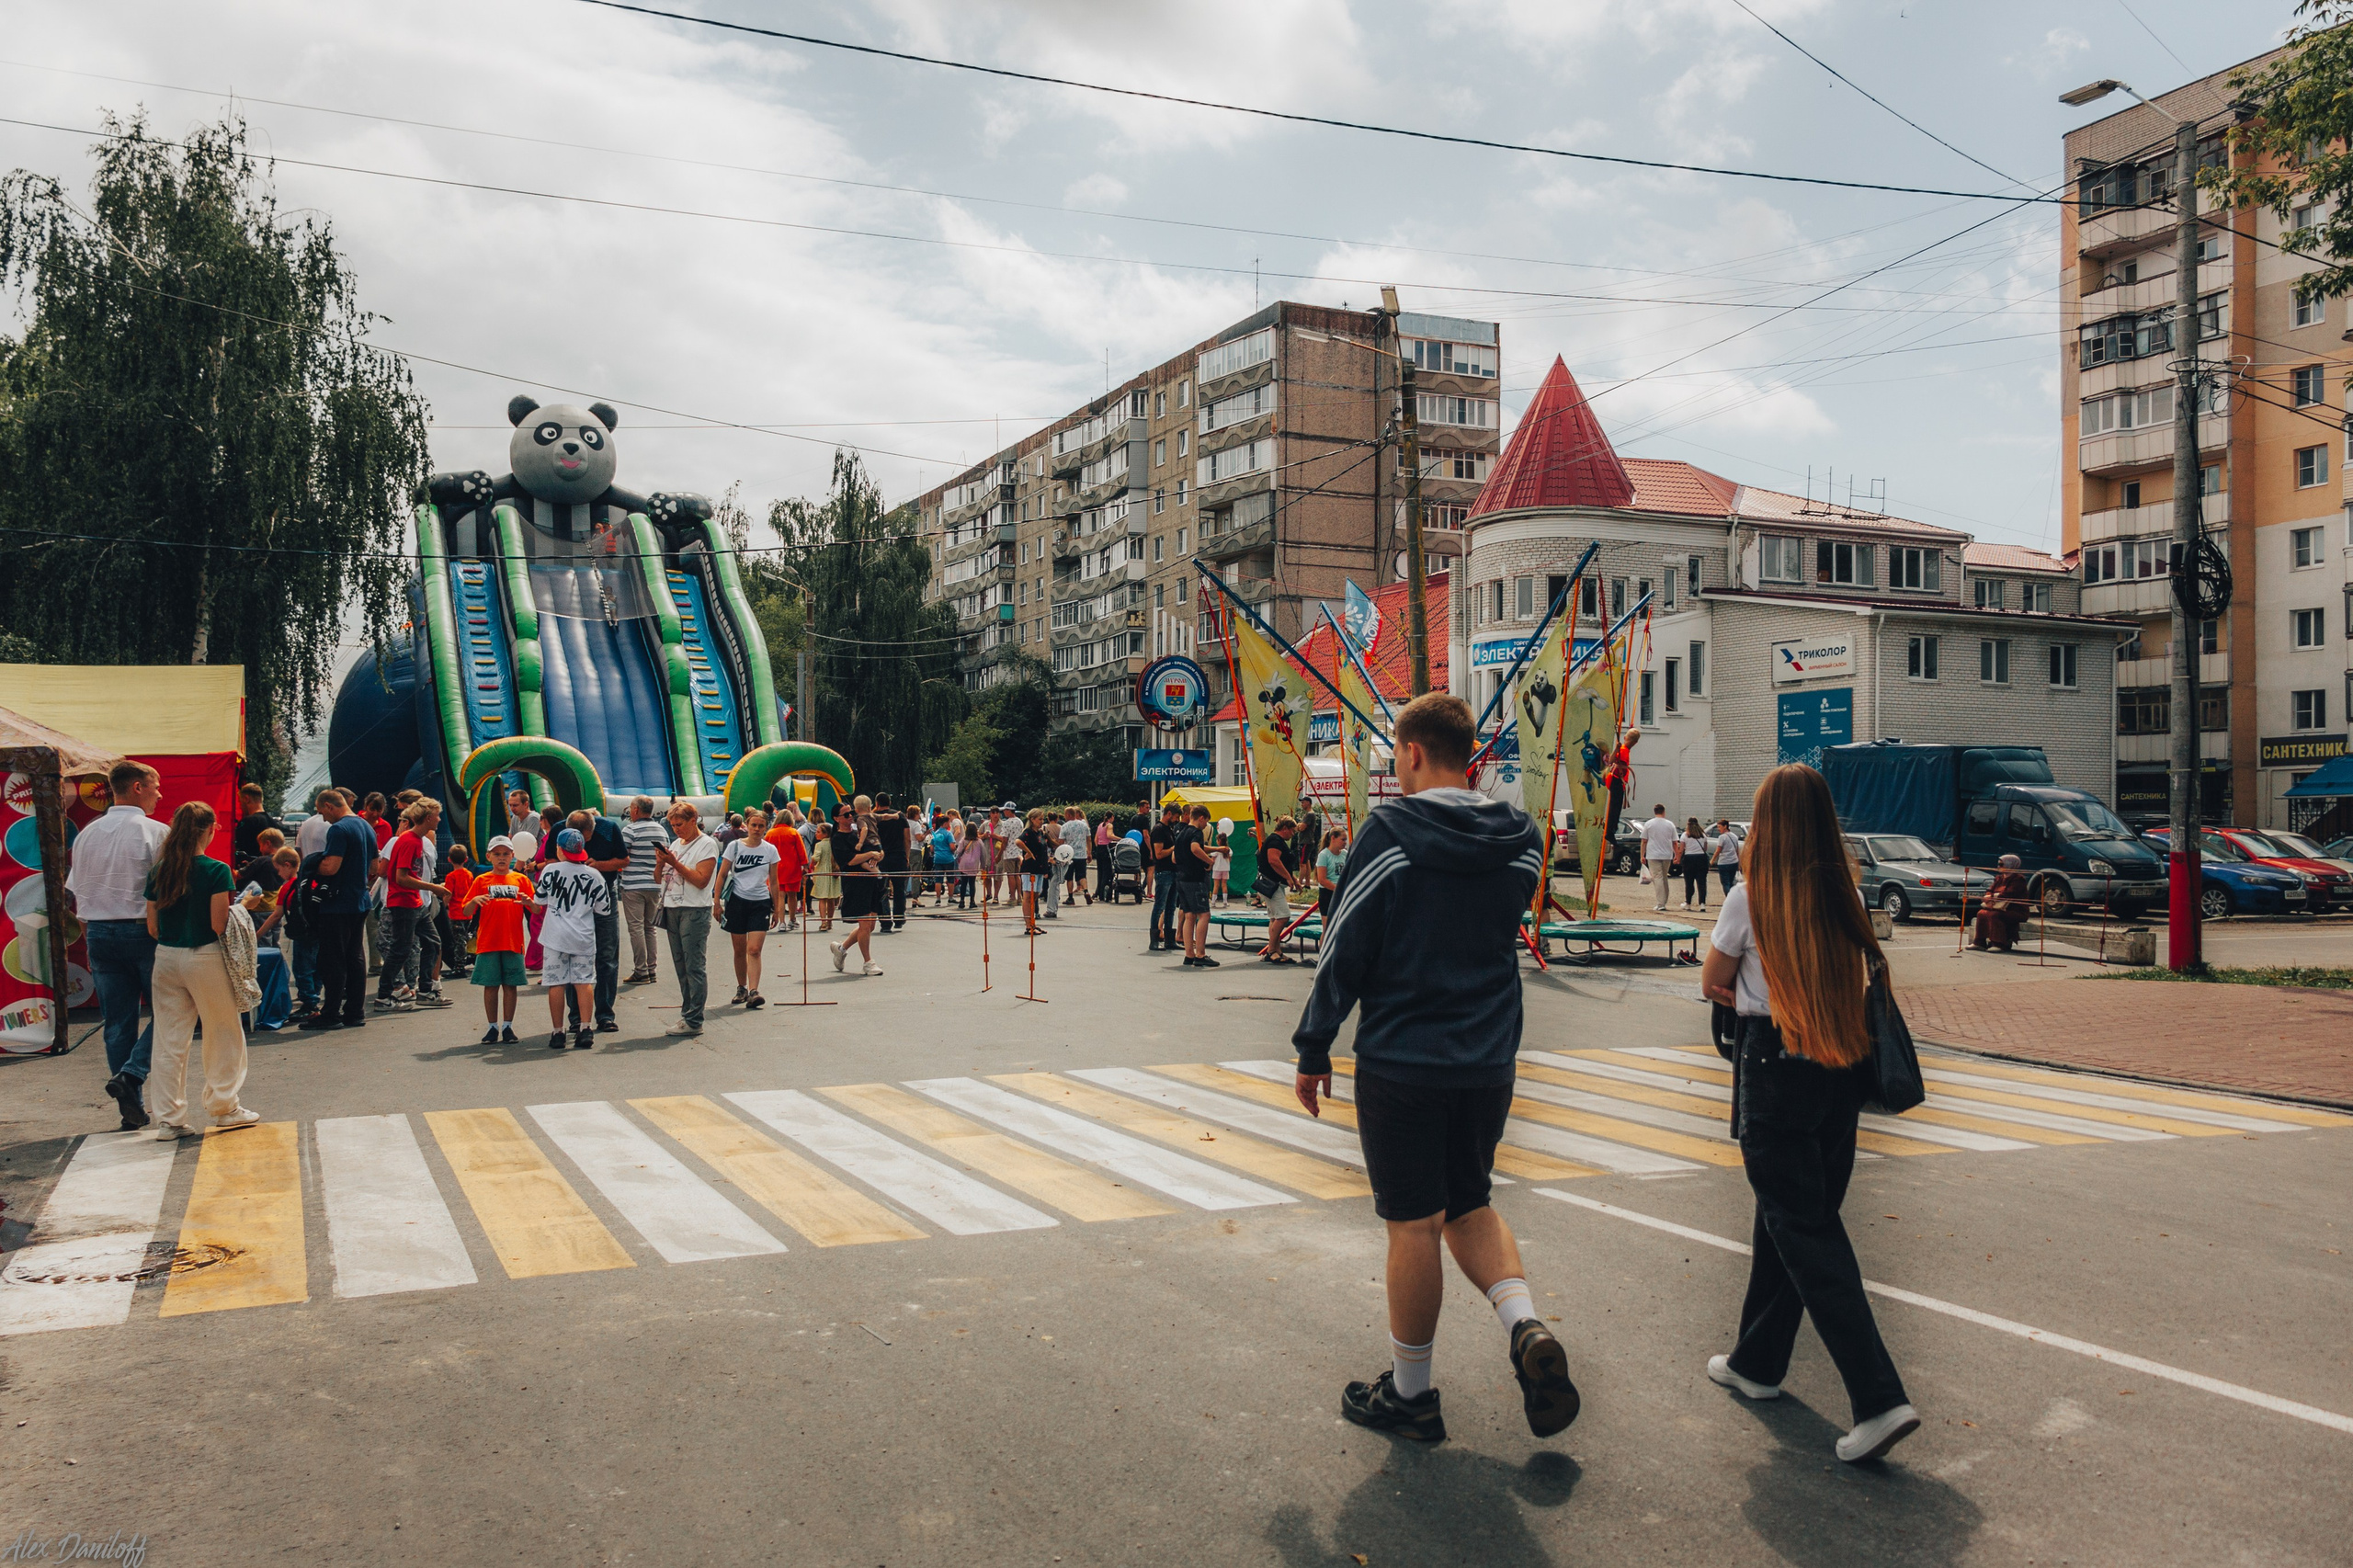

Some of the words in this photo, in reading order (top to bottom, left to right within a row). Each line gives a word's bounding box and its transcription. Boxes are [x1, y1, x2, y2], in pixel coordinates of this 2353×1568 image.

[1798, 646, 1847, 660] ТРИКОЛОР
[1141, 767, 1208, 776] ЭЛЕКТРОНИКА
[2120, 792, 2167, 801] САНТЕХНИКА
[737, 855, 764, 865] NIKE
